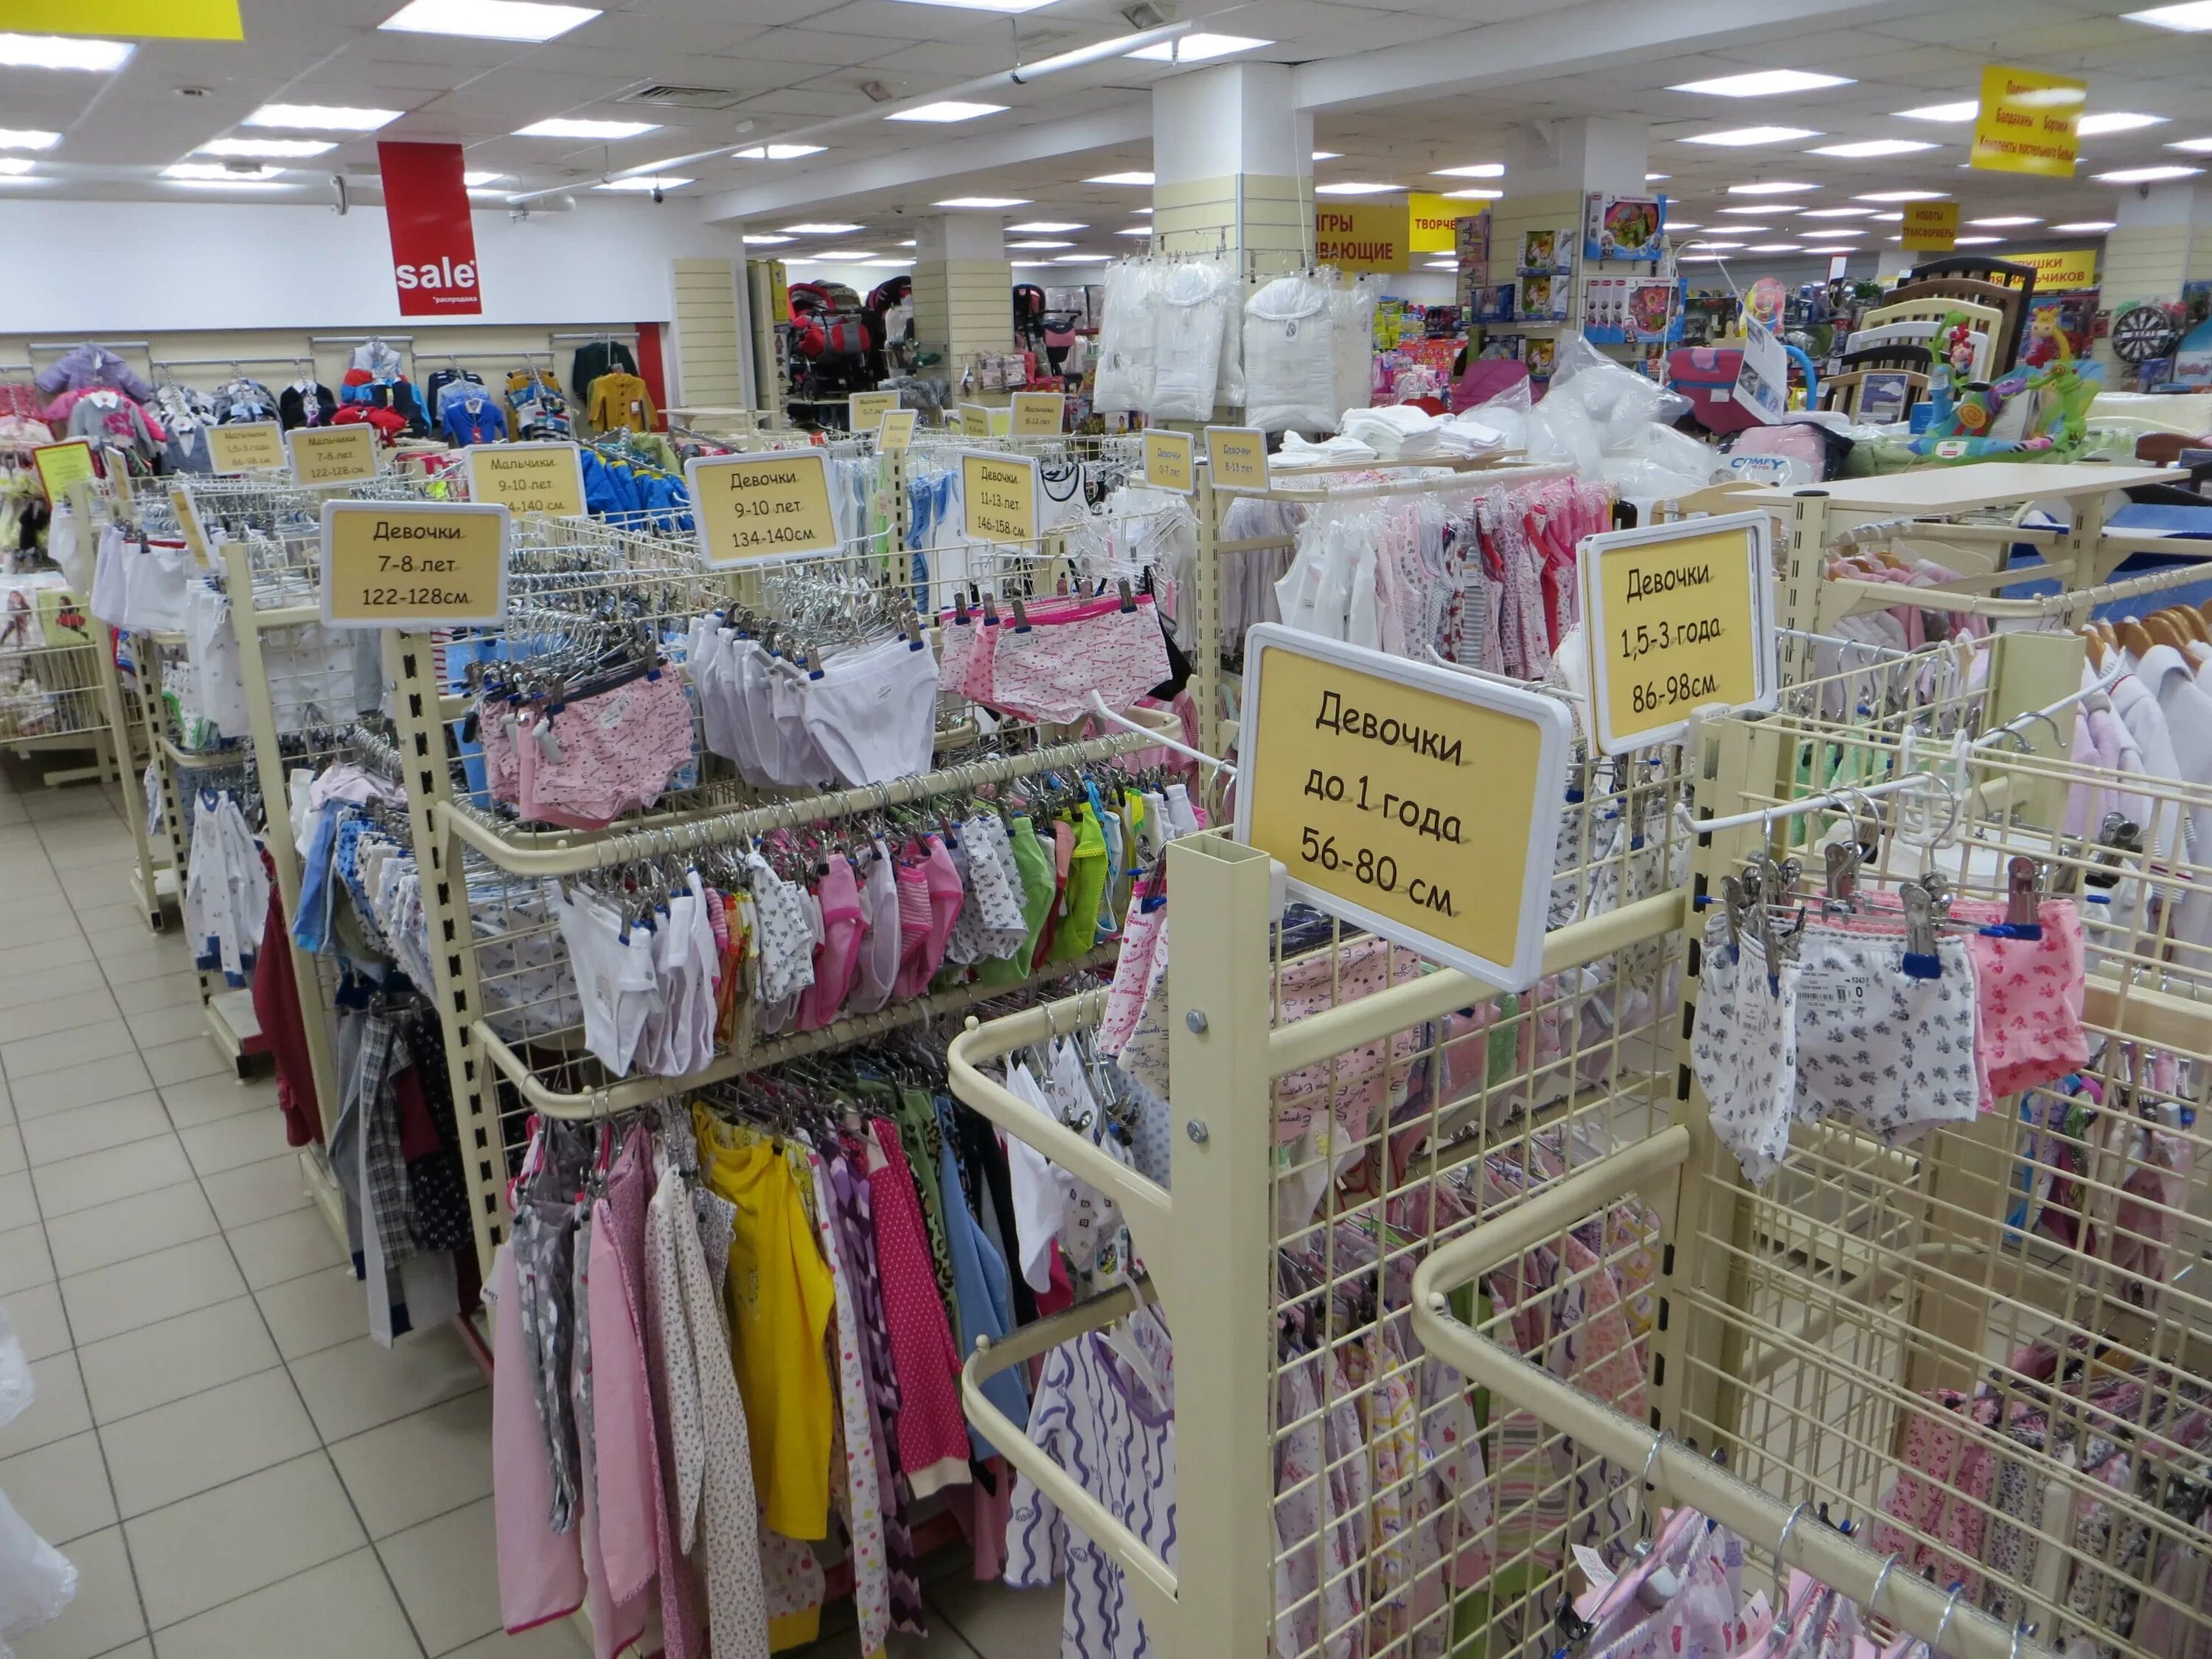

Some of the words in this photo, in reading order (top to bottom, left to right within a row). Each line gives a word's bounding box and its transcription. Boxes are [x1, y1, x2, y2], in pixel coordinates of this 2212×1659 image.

[308, 436, 357, 446] Мальчики
[316, 453, 334, 462] 7-8
[335, 451, 353, 459] лет
[1157, 448, 1180, 460] Девочки
[1223, 445, 1251, 455] Девочки
[310, 467, 349, 478] 122-128
[491, 459, 554, 470] Мальчики
[1170, 467, 1180, 477] лет
[1241, 465, 1253, 473] лет
[730, 473, 796, 491] Девочки
[981, 467, 1018, 484] Девочки
[498, 479, 526, 493] 9-10
[530, 479, 552, 490] лет
[547, 502, 564, 510] см
[734, 501, 769, 518] 9-10
[774, 501, 801, 514] лет
[981, 492, 1001, 507] 11-13
[1004, 501, 1020, 511] лет
[373, 522, 462, 542] Девочки
[978, 516, 1010, 535] 146-158
[1012, 526, 1026, 538] см
[732, 527, 815, 547] 134-140см
[378, 555, 414, 572] 7-8
[420, 560, 456, 572] лет
[1627, 565, 1709, 603] Девочки
[363, 589, 470, 605] 122-128см
[1621, 622, 1669, 661] 1,5-3
[1677, 618, 1721, 645] года
[1632, 673, 1717, 714] 86-98см
[1315, 691, 1462, 766] Девочки
[1304, 769, 1345, 801] до
[1357, 775, 1370, 810] 1
[1383, 793, 1461, 844] года
[1301, 826, 1397, 891] 56-80
[1408, 878, 1453, 917] см
